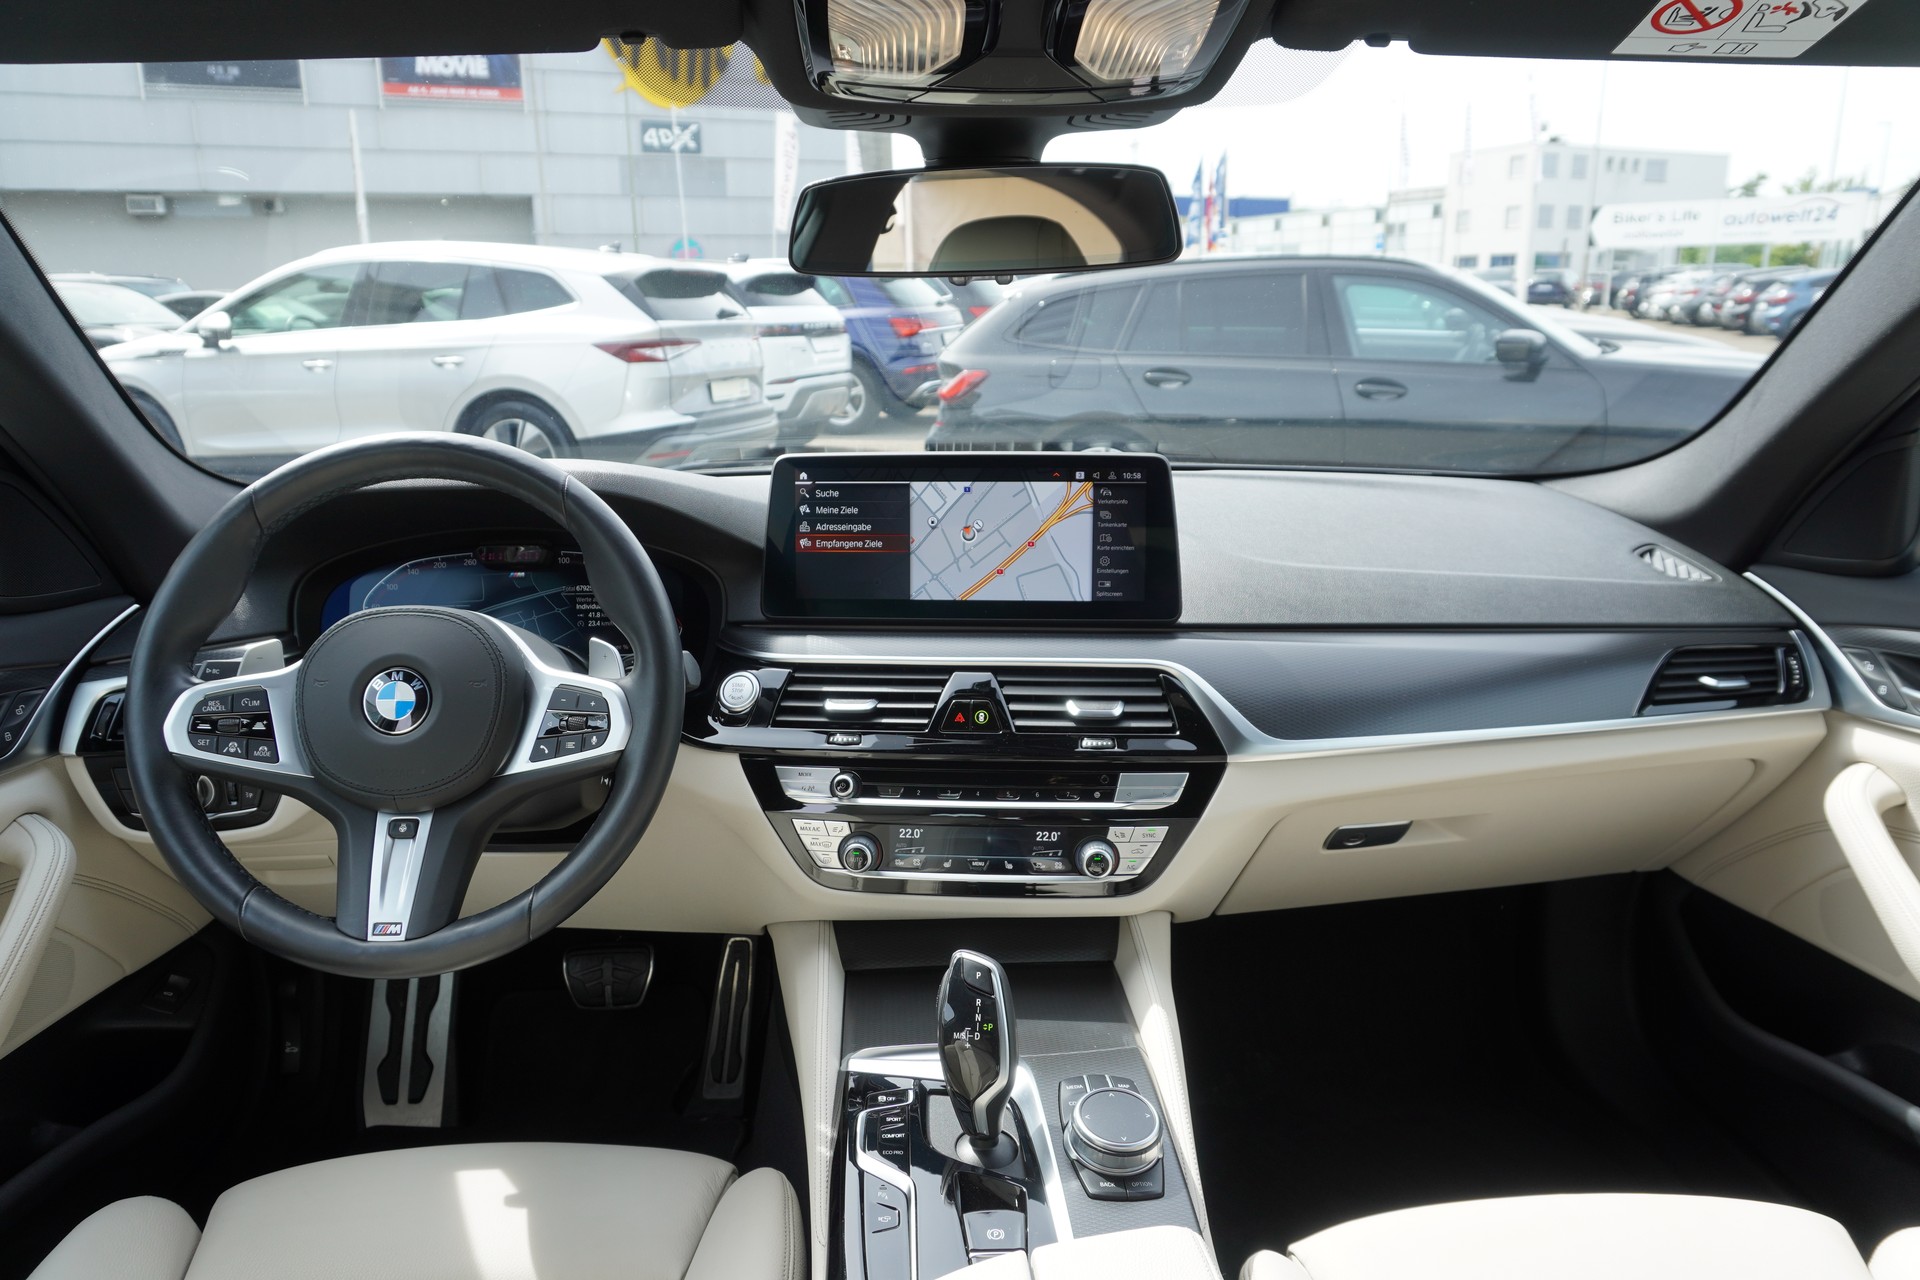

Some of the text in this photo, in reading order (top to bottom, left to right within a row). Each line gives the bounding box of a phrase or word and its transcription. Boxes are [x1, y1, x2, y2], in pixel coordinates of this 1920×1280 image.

[643, 124, 699, 150] 4DX
[815, 489, 839, 498] Suche
[815, 506, 859, 514] Meine Ziele
[815, 523, 872, 532] Adresseingabe
[816, 540, 883, 549] Empfangene Ziele
[463, 558, 477, 566] 260
[372, 671, 424, 690] BMW
[976, 998, 982, 1006] R
